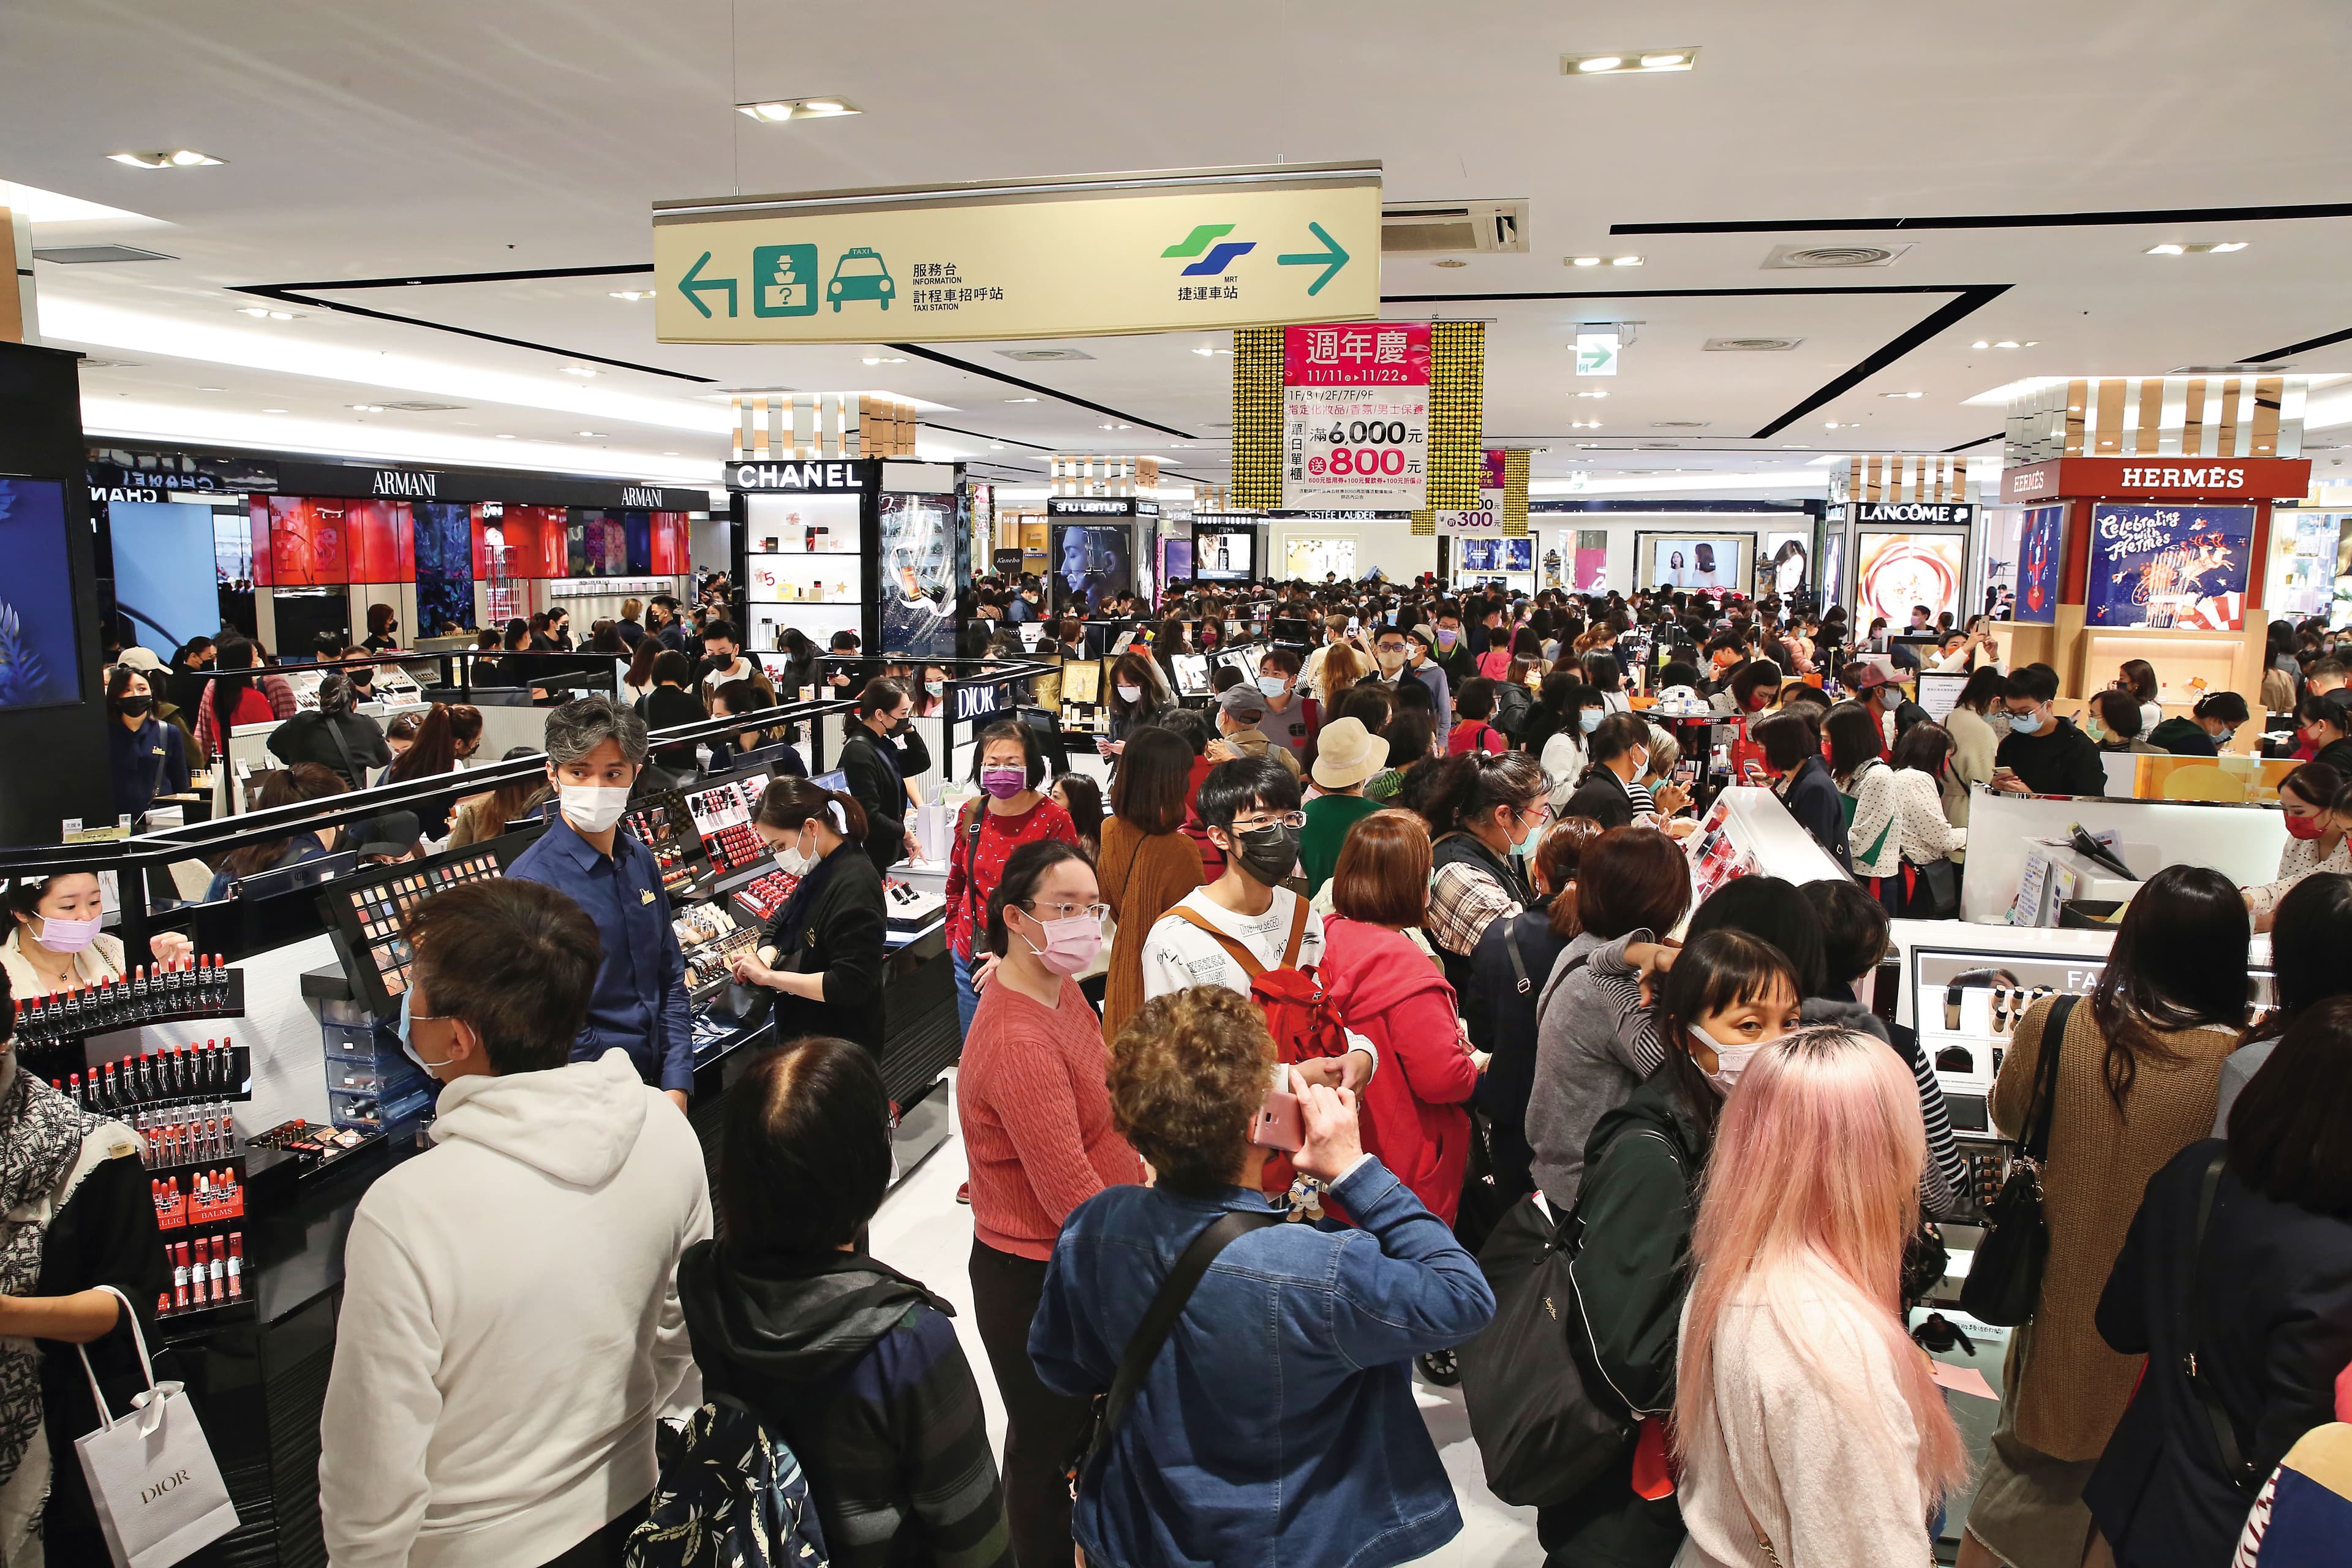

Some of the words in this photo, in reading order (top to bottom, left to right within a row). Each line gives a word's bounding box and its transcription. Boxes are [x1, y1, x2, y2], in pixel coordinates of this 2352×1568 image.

[913, 262, 957, 277] 服務台
[913, 276, 962, 285] INFORMATION
[913, 286, 1004, 304] 計程車招呼站
[1178, 285, 1238, 301] 捷運車站
[1305, 331, 1408, 364] 週年慶
[1290, 423, 1303, 481] 單日單櫃
[372, 470, 437, 497] ARMANI
[737, 464, 863, 488] CHANEL
[621, 486, 663, 508] ARMANI
[1056, 501, 1078, 512] shu
[1080, 502, 1128, 512] uemura
[1338, 510, 1376, 520] LAUDER
[1860, 503, 1950, 521] LANCÔME
[2097, 510, 2180, 539] Celebrating
[2133, 527, 2162, 541] with
[957, 685, 995, 720] DIOR
[2067, 970, 2097, 989] FA
[159, 1216, 183, 1227] LLIC
[201, 1208, 233, 1219] BALMS
[141, 1469, 192, 1504] DIOR
